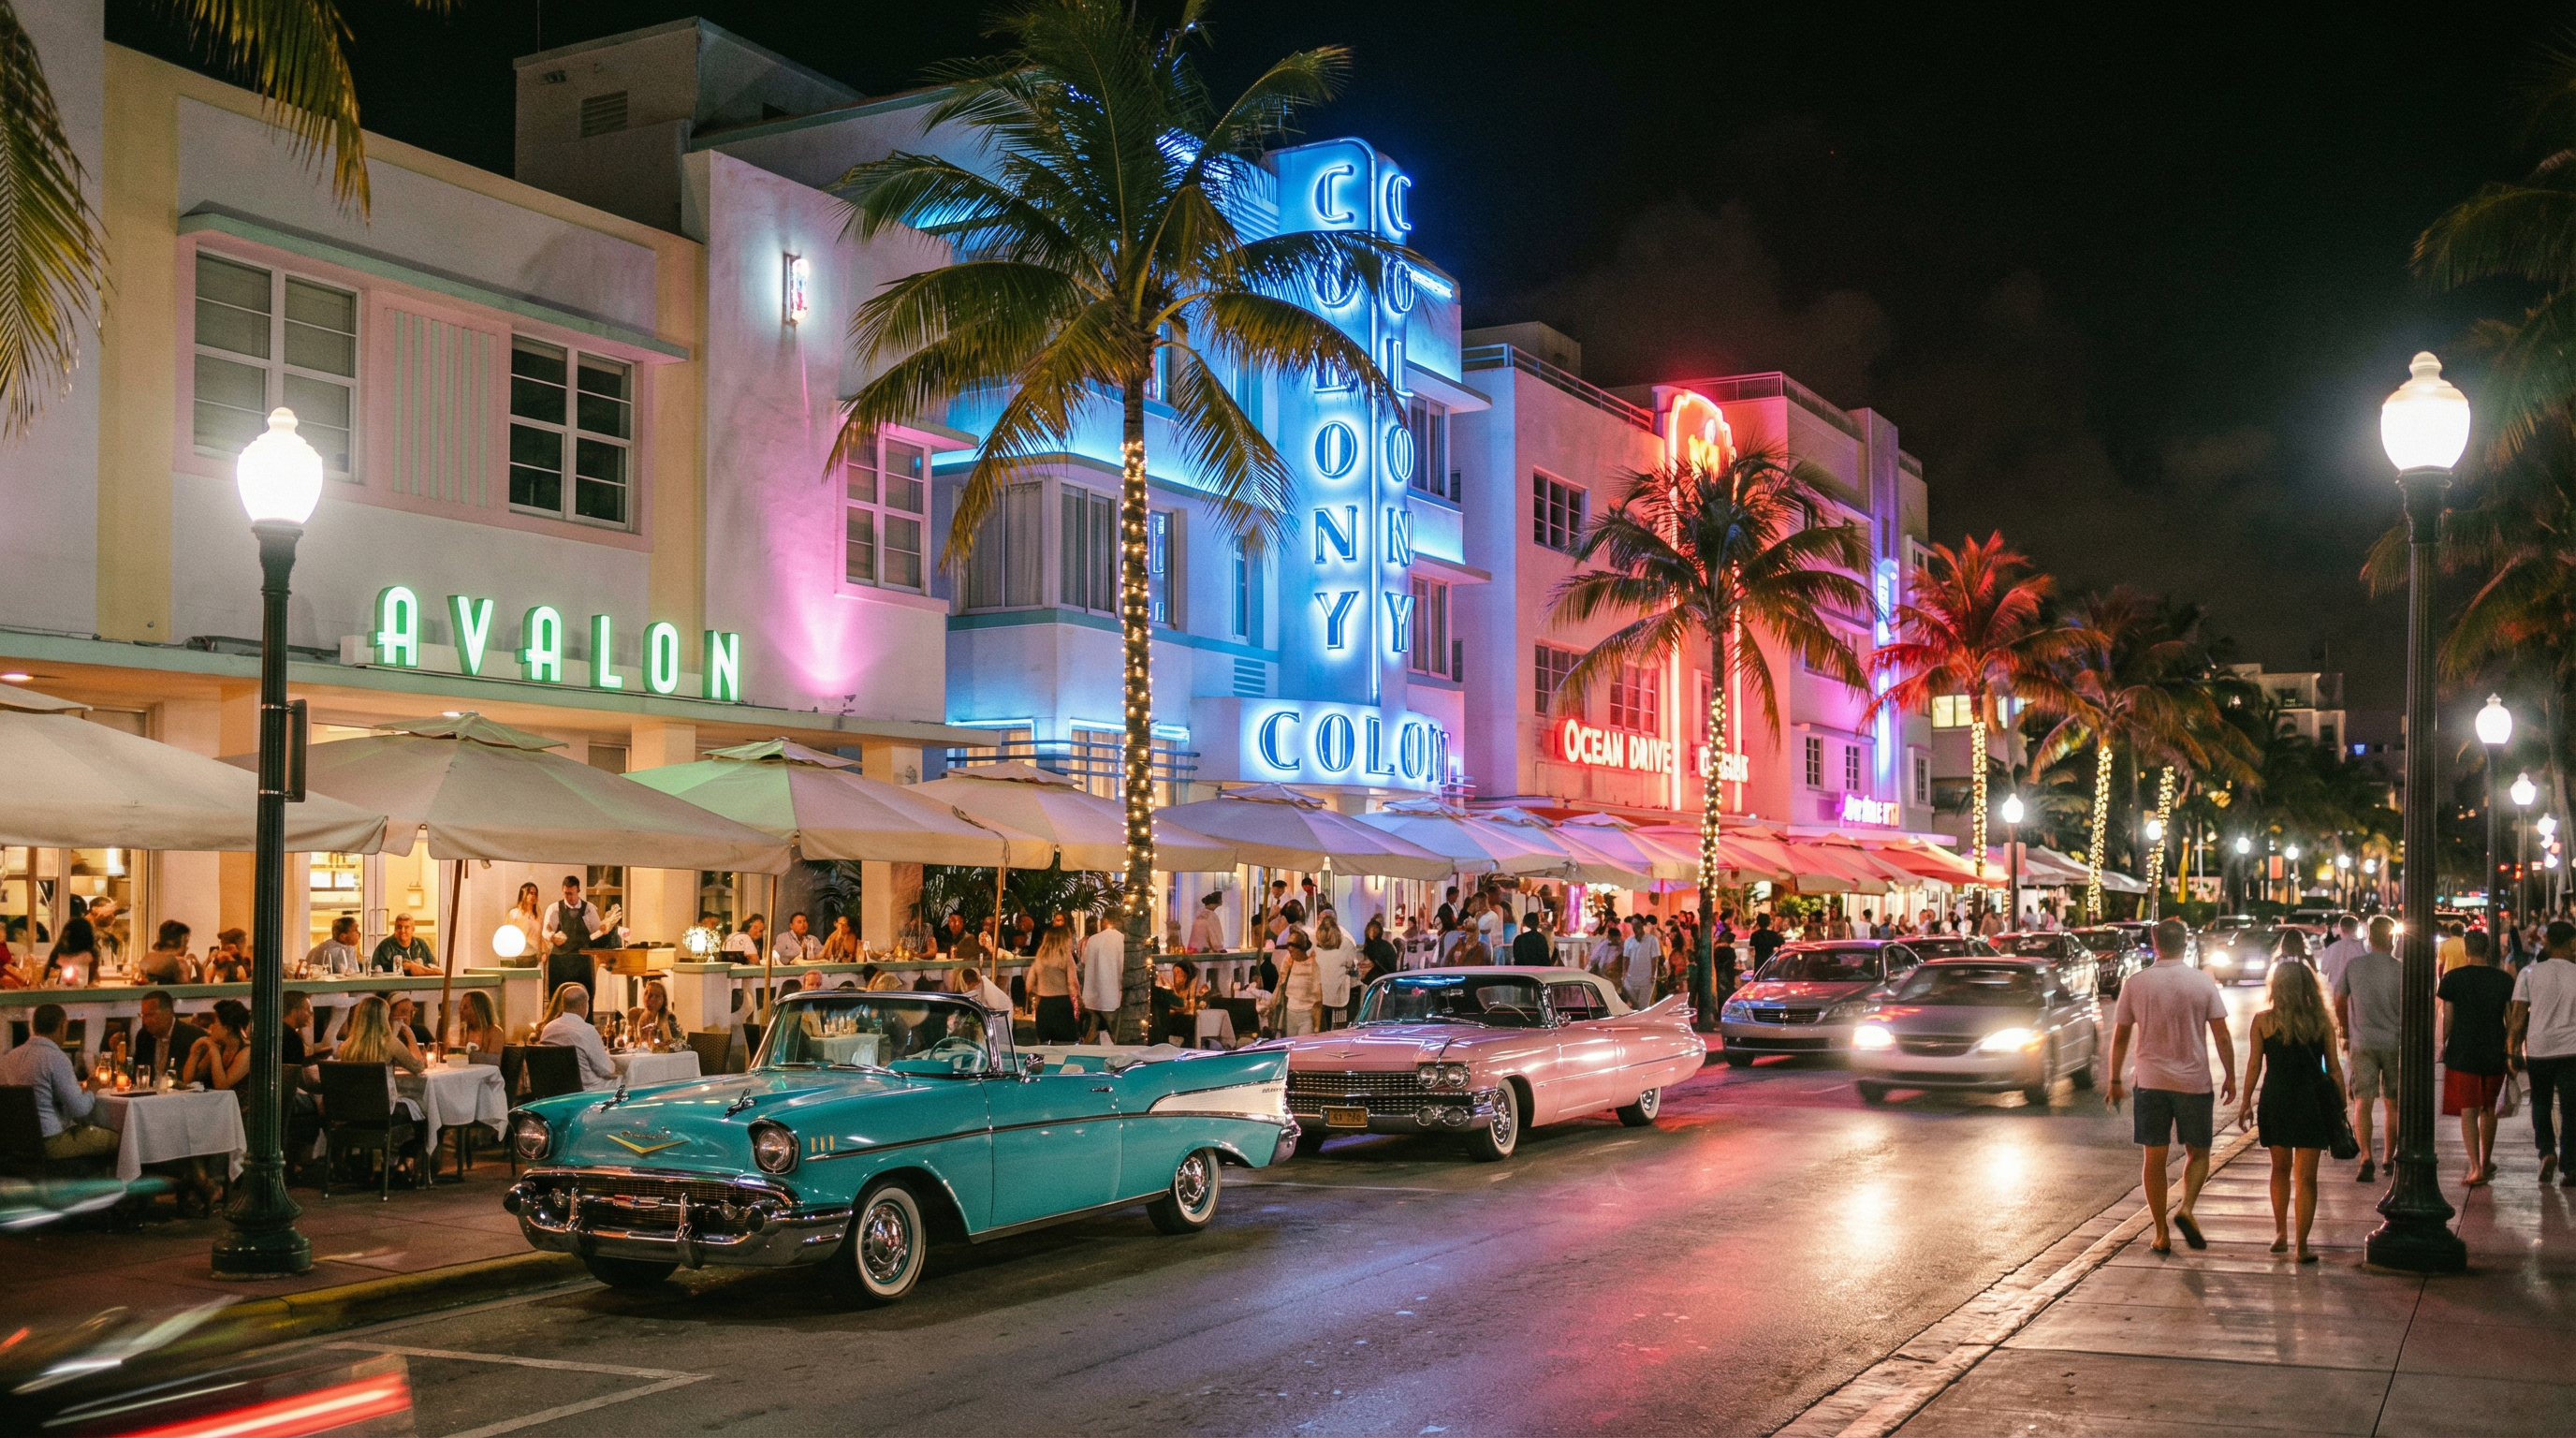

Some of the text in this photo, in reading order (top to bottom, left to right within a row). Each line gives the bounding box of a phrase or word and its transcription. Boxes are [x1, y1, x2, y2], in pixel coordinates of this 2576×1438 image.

[1385, 173, 1416, 653] COLONY
[366, 585, 741, 703] AVALON
[1564, 718, 1624, 769] OCEAN
[1629, 735, 1672, 775] DRIVE
